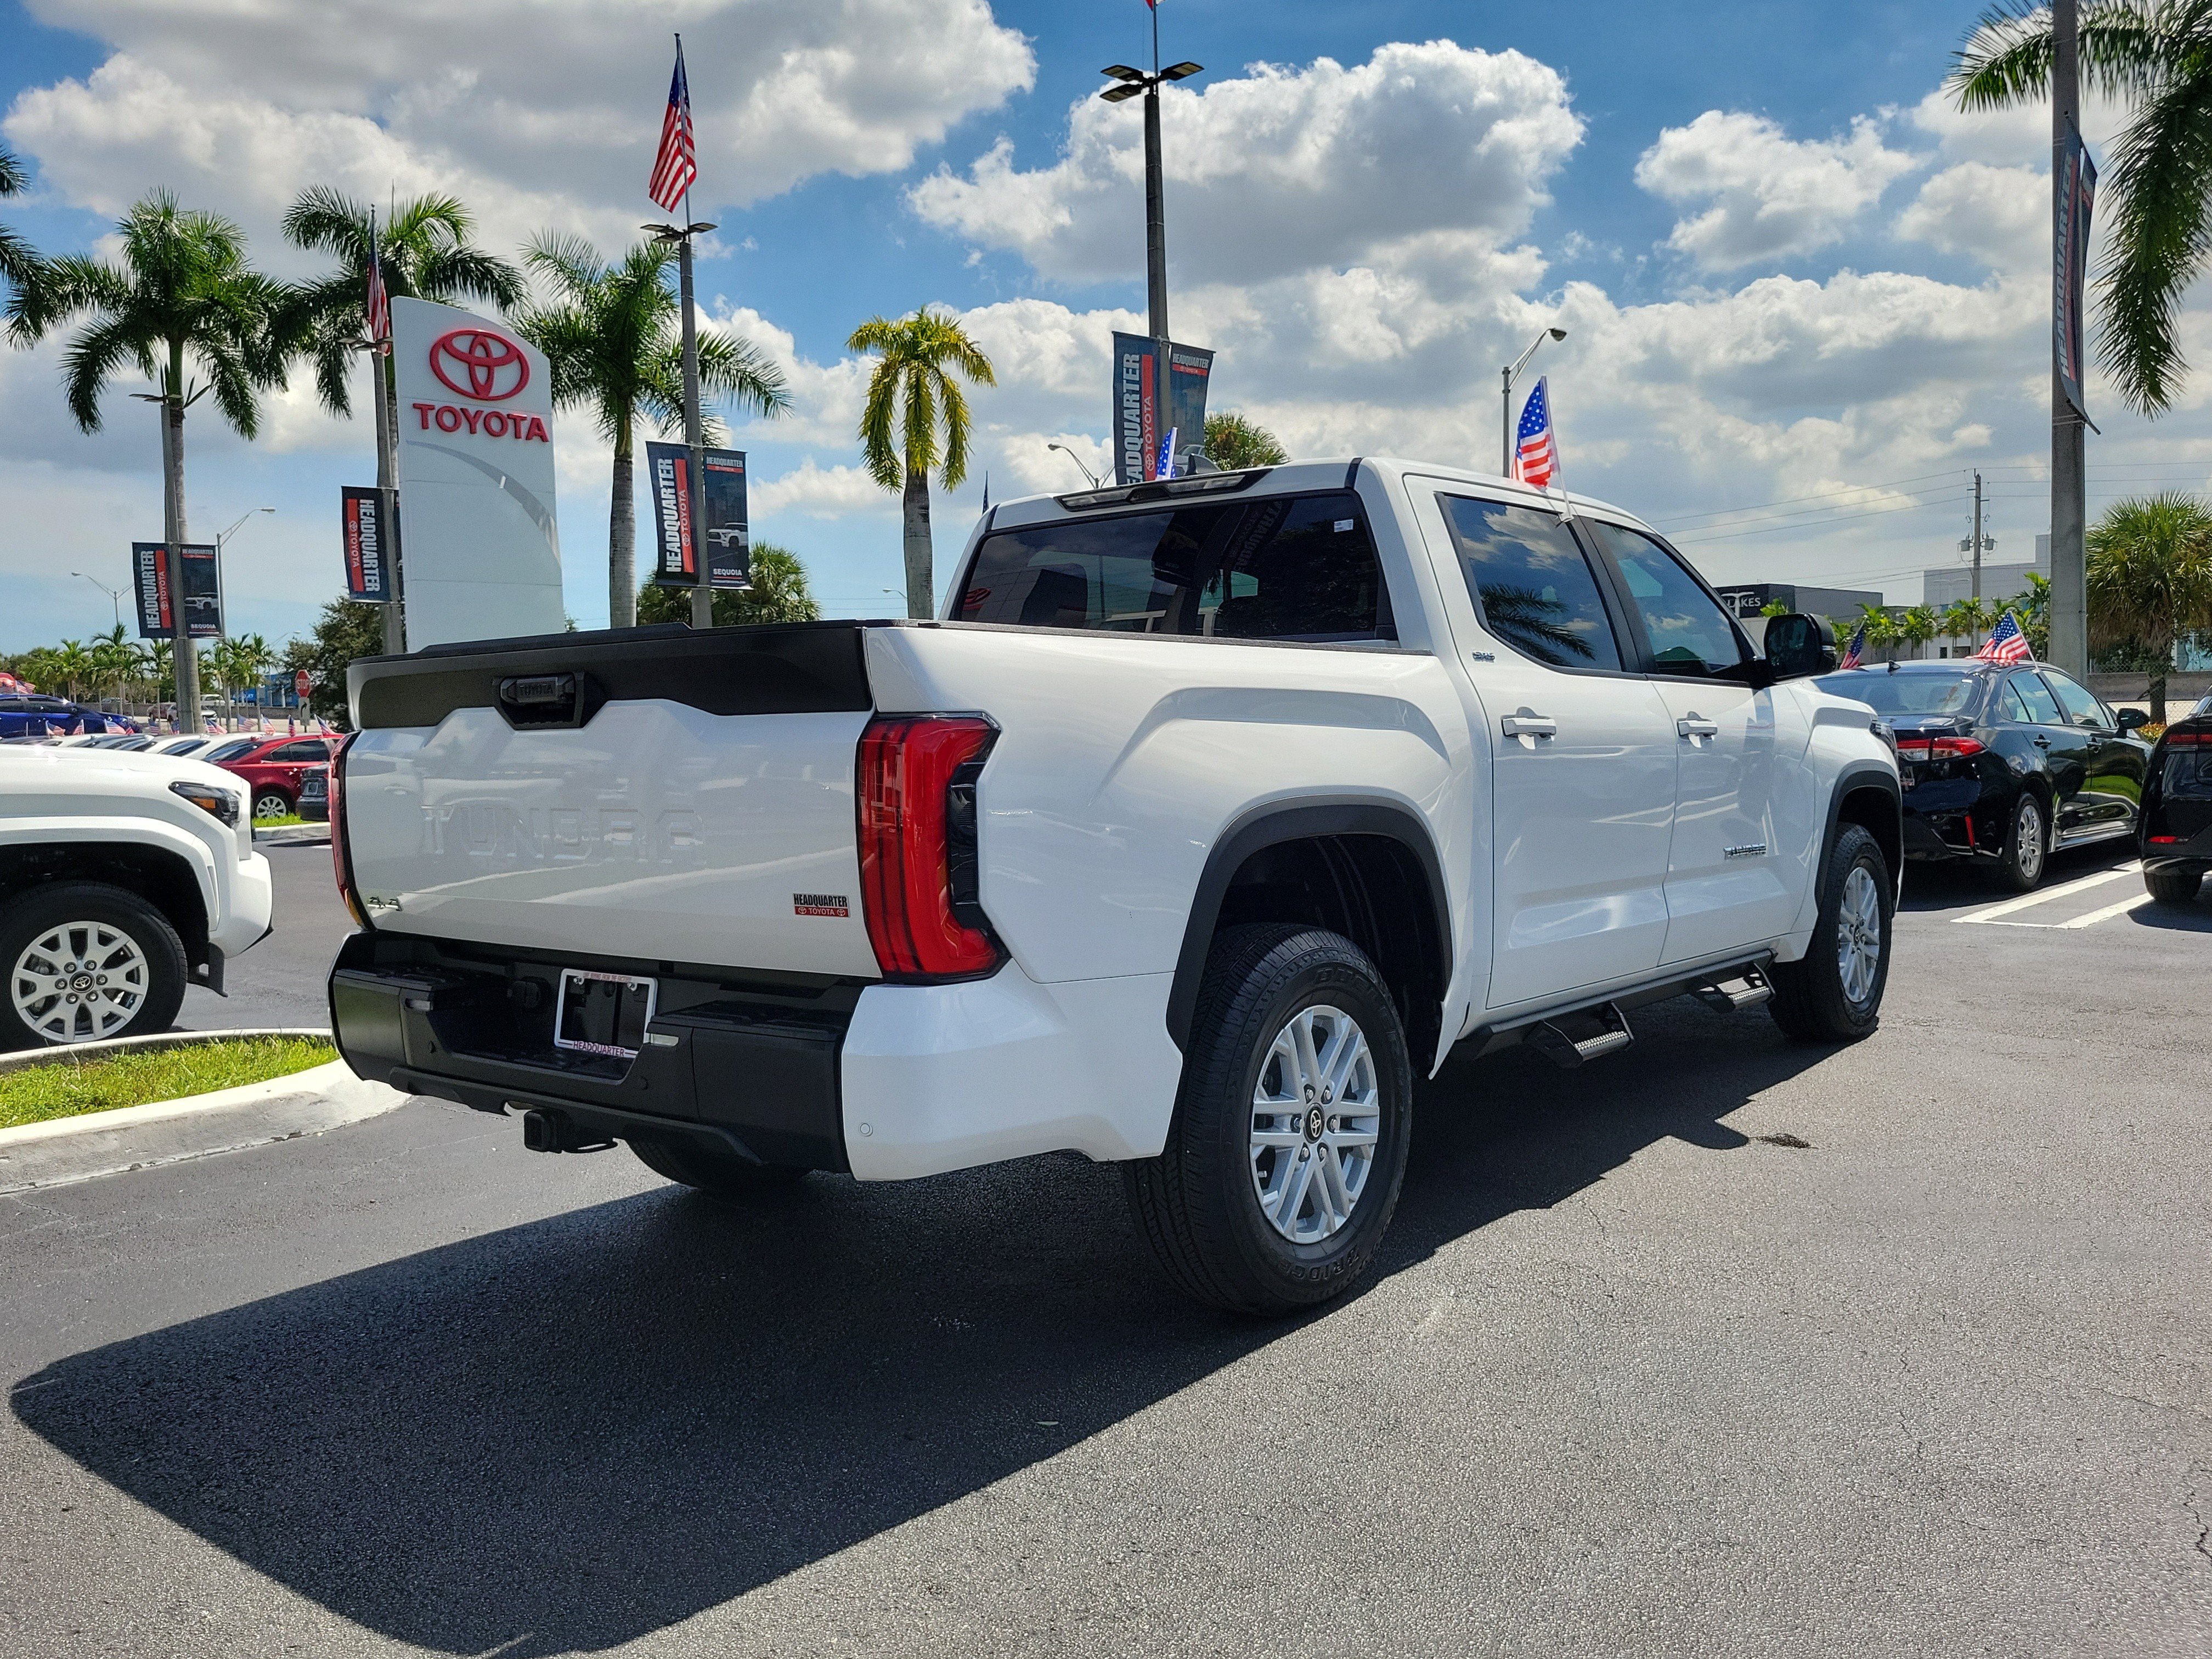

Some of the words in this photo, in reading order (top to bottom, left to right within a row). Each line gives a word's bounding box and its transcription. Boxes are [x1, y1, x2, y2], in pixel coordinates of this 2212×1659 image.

[2056, 151, 2073, 379] HEADQUARTER
[1172, 353, 1210, 369] HEADQUARTER
[413, 403, 550, 442] TOYOTA
[1122, 353, 1143, 485] EADQUARTER
[1144, 396, 1154, 452] TOYOTA
[706, 456, 743, 468] HEADQUARTER
[657, 458, 682, 572] HEADQUARTER
[679, 489, 689, 532] TOYOTA
[351, 533, 360, 568] TOYOTA
[359, 499, 381, 592] HEADQUARTER
[140, 550, 161, 629] HEADQUARTER
[159, 571, 167, 602] TOYOTA
[713, 568, 743, 577] SEQUOIA
[1726, 597, 1761, 608] LKES
[296, 678, 310, 689] STOP
[420, 804, 704, 865] TUNDRA
[793, 894, 848, 907] HEADQUARTER
[808, 907, 835, 916] TOYOTA
[573, 1041, 625, 1057] HEADQUARTER
